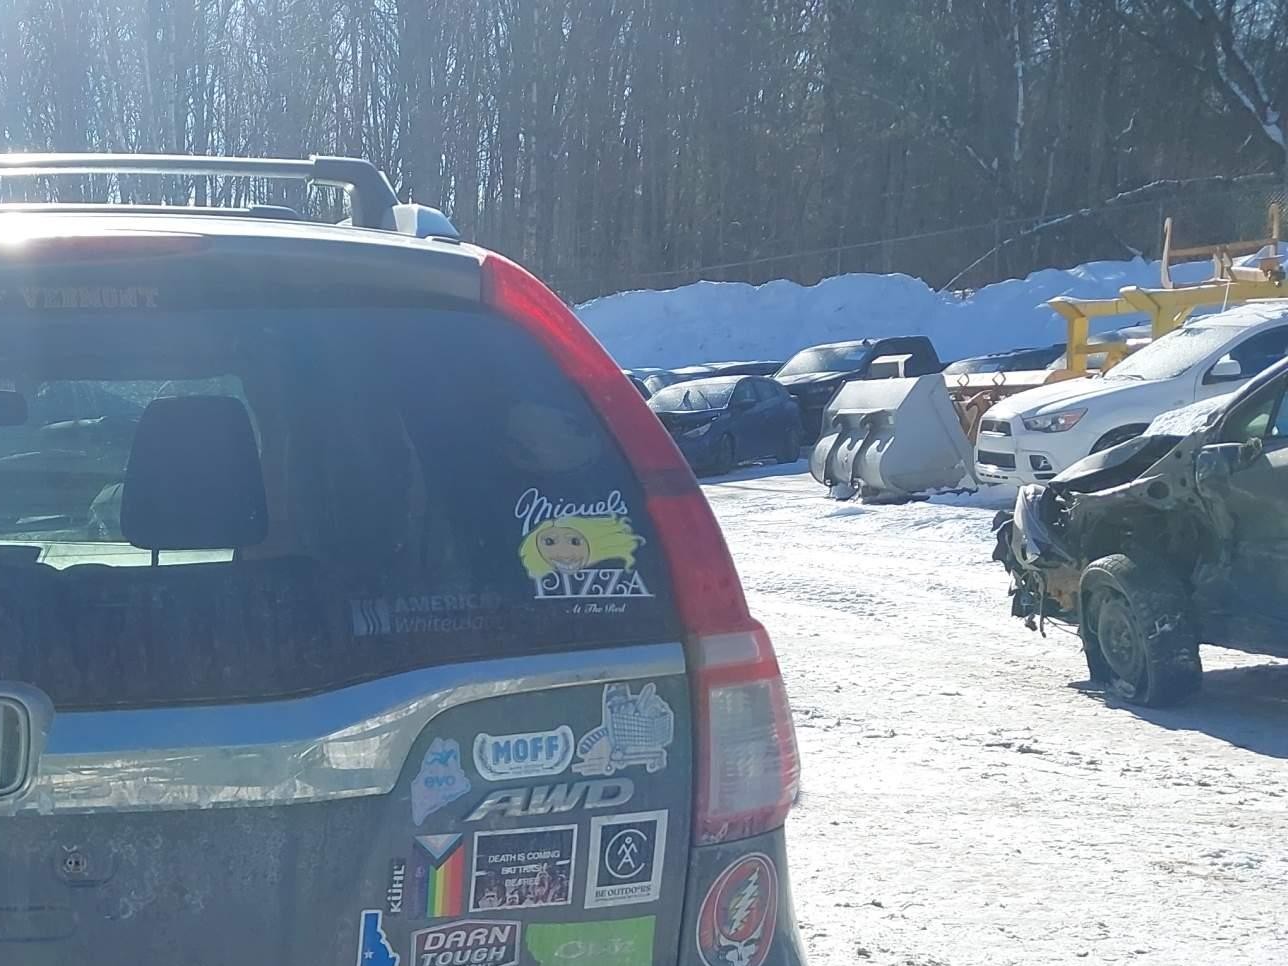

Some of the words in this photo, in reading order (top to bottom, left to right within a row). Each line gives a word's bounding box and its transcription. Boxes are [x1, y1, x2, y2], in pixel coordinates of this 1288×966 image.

[535, 567, 655, 599] PIZZA
[491, 735, 560, 766] MOFF
[423, 774, 456, 789] evo
[464, 777, 635, 823] AWD
[488, 852, 516, 864] DEATH
[517, 852, 526, 862] IS
[423, 925, 512, 951] DARN
